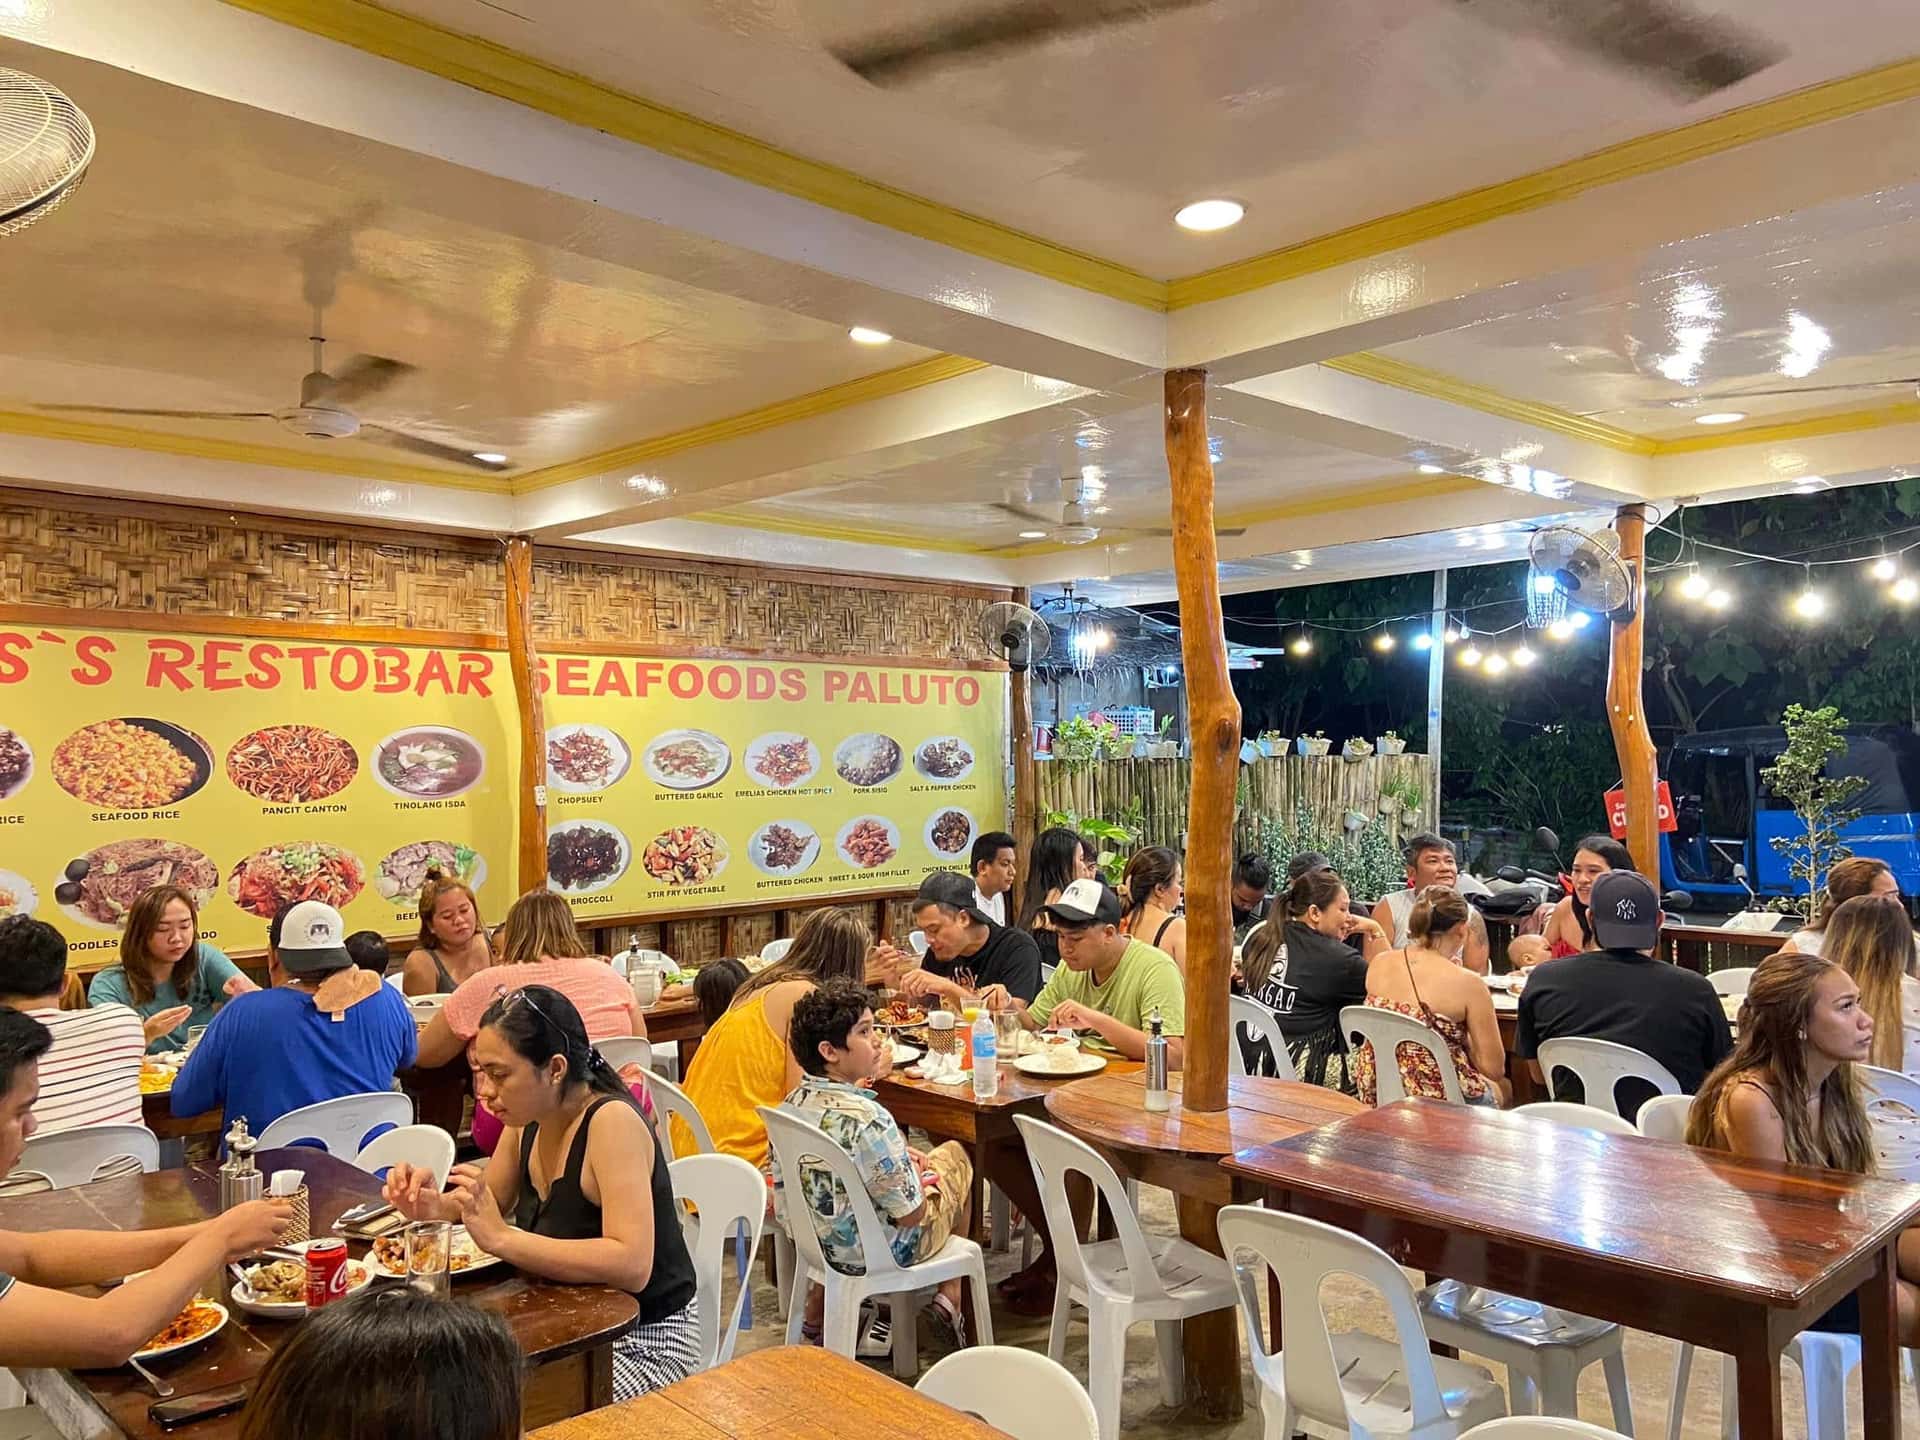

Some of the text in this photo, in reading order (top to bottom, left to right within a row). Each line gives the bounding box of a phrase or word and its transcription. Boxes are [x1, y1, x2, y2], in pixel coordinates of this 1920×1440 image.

[146, 638, 494, 699] RESTOBAR
[823, 669, 981, 707] PALUTO
[766, 788, 797, 797] CHICKEN
[798, 788, 812, 796] HOT
[814, 787, 833, 795] SPICY
[931, 784, 951, 792] PEPPER
[952, 783, 976, 791] CHICKEN
[557, 795, 603, 805] CHOPSUEY
[654, 791, 723, 801] BUTTERED GARLIC
[262, 804, 347, 815] PANCIT CANTON
[393, 800, 466, 810] TINOLANG ISDA
[91, 810, 181, 822] SEAFOOD RICE
[922, 864, 947, 873] CHICKEN
[828, 874, 850, 882] SWEET
[857, 872, 875, 880] SOUR
[890, 869, 910, 877] FILLET
[756, 876, 823, 888] BUTTERED CHICKEN
[648, 885, 726, 899] STIR FRY VEGETABLE
[570, 895, 613, 905] BROCCOLI
[66, 939, 119, 951] OODLES
